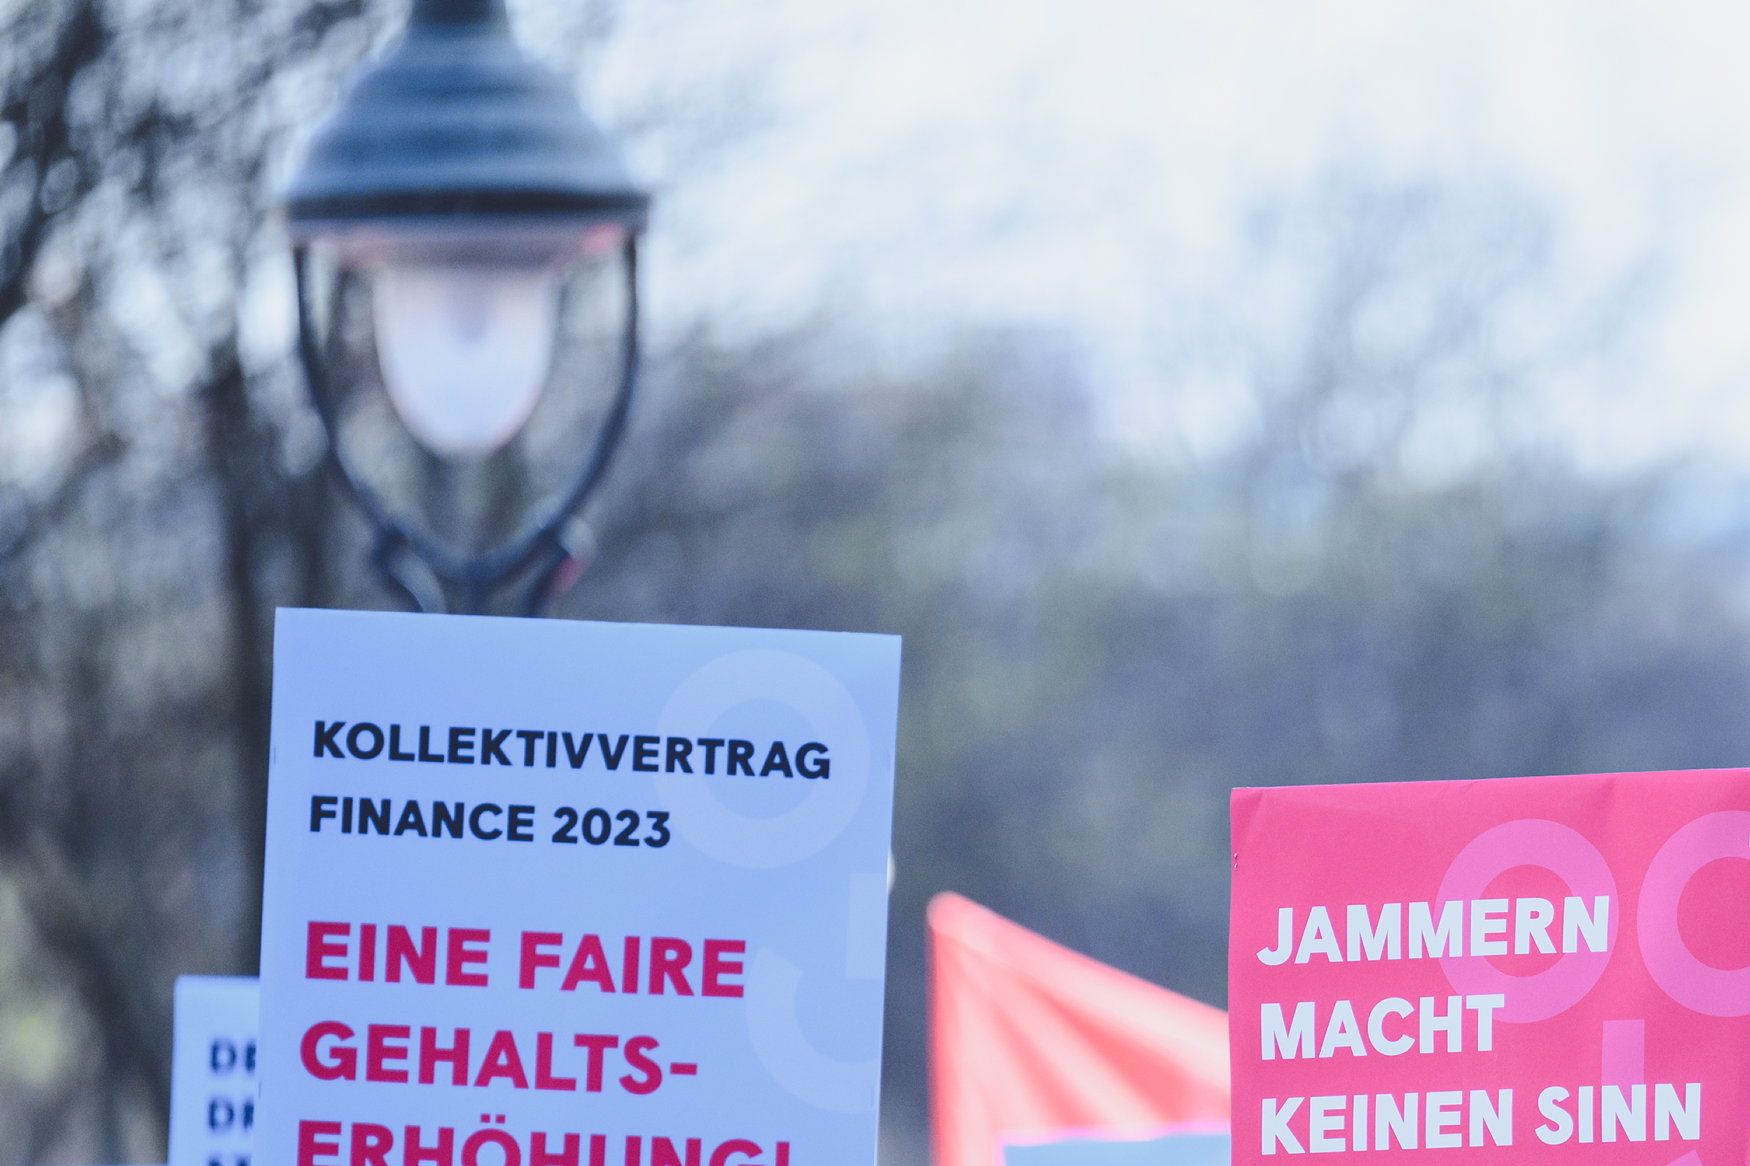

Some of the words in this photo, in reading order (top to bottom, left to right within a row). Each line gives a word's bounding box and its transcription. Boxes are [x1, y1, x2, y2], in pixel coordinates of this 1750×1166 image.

[312, 720, 831, 780] KOLLEKTIVVERTRAG
[309, 796, 535, 842] FINANCE
[551, 806, 671, 848] 2023
[305, 920, 491, 988] EINE
[518, 930, 747, 998] FAIRE
[1256, 895, 1610, 966] JAMMERN
[300, 1020, 698, 1095] GEHALTS-
[1260, 993, 1505, 1061] MACHT
[1261, 1088, 1513, 1155] KEINEN
[1534, 1082, 1702, 1146] SINN
